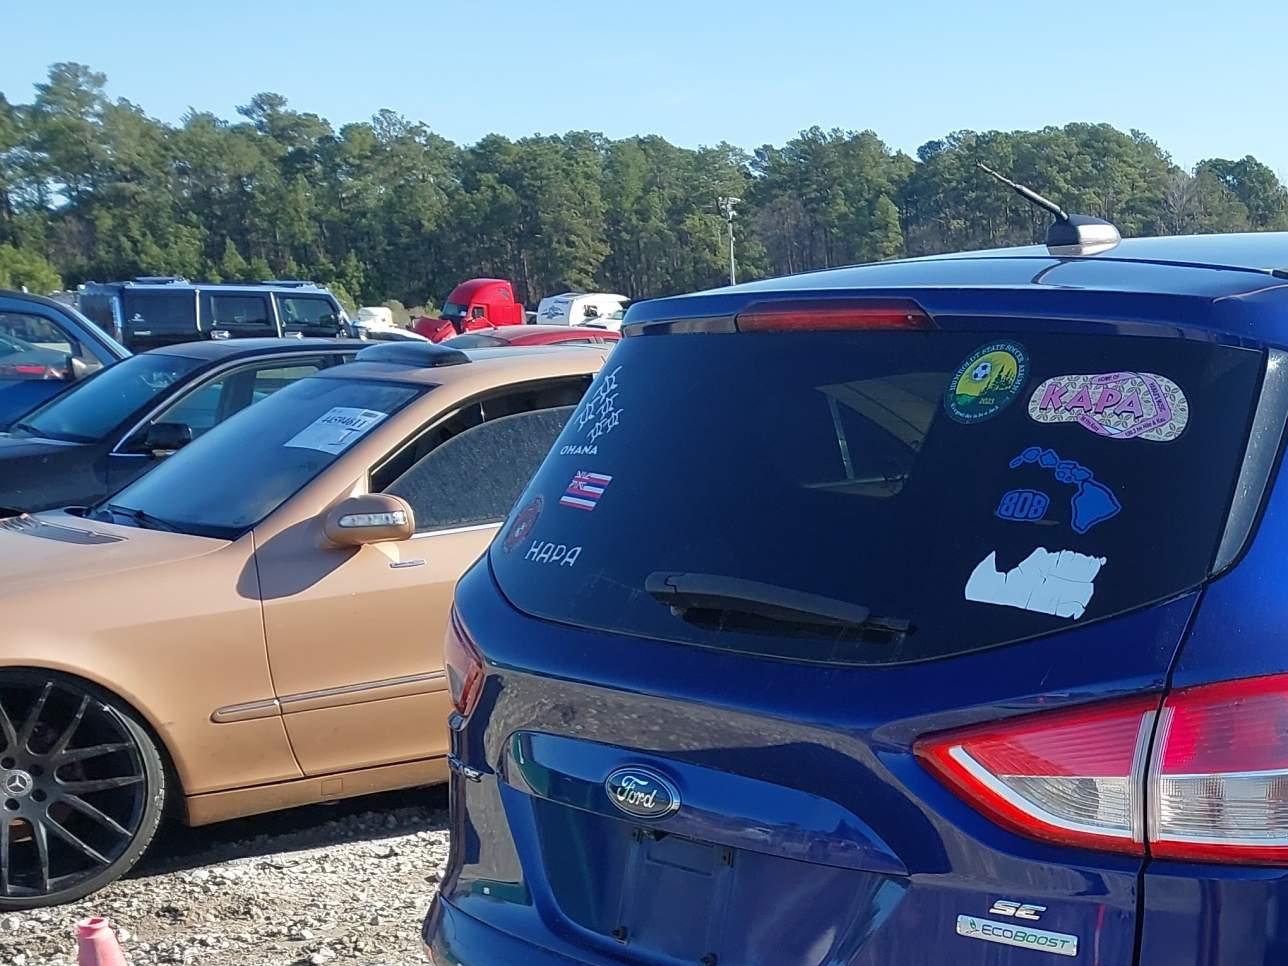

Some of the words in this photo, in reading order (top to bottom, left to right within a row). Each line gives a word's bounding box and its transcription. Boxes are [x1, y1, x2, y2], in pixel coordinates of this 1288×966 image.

[1039, 383, 1143, 419] KAPA
[560, 444, 598, 456] OHANA
[999, 492, 1047, 519] 808
[524, 540, 582, 567] HAPA
[616, 775, 657, 809] Ford
[989, 899, 1047, 921] SE
[981, 924, 1070, 949] ECOBOOST
